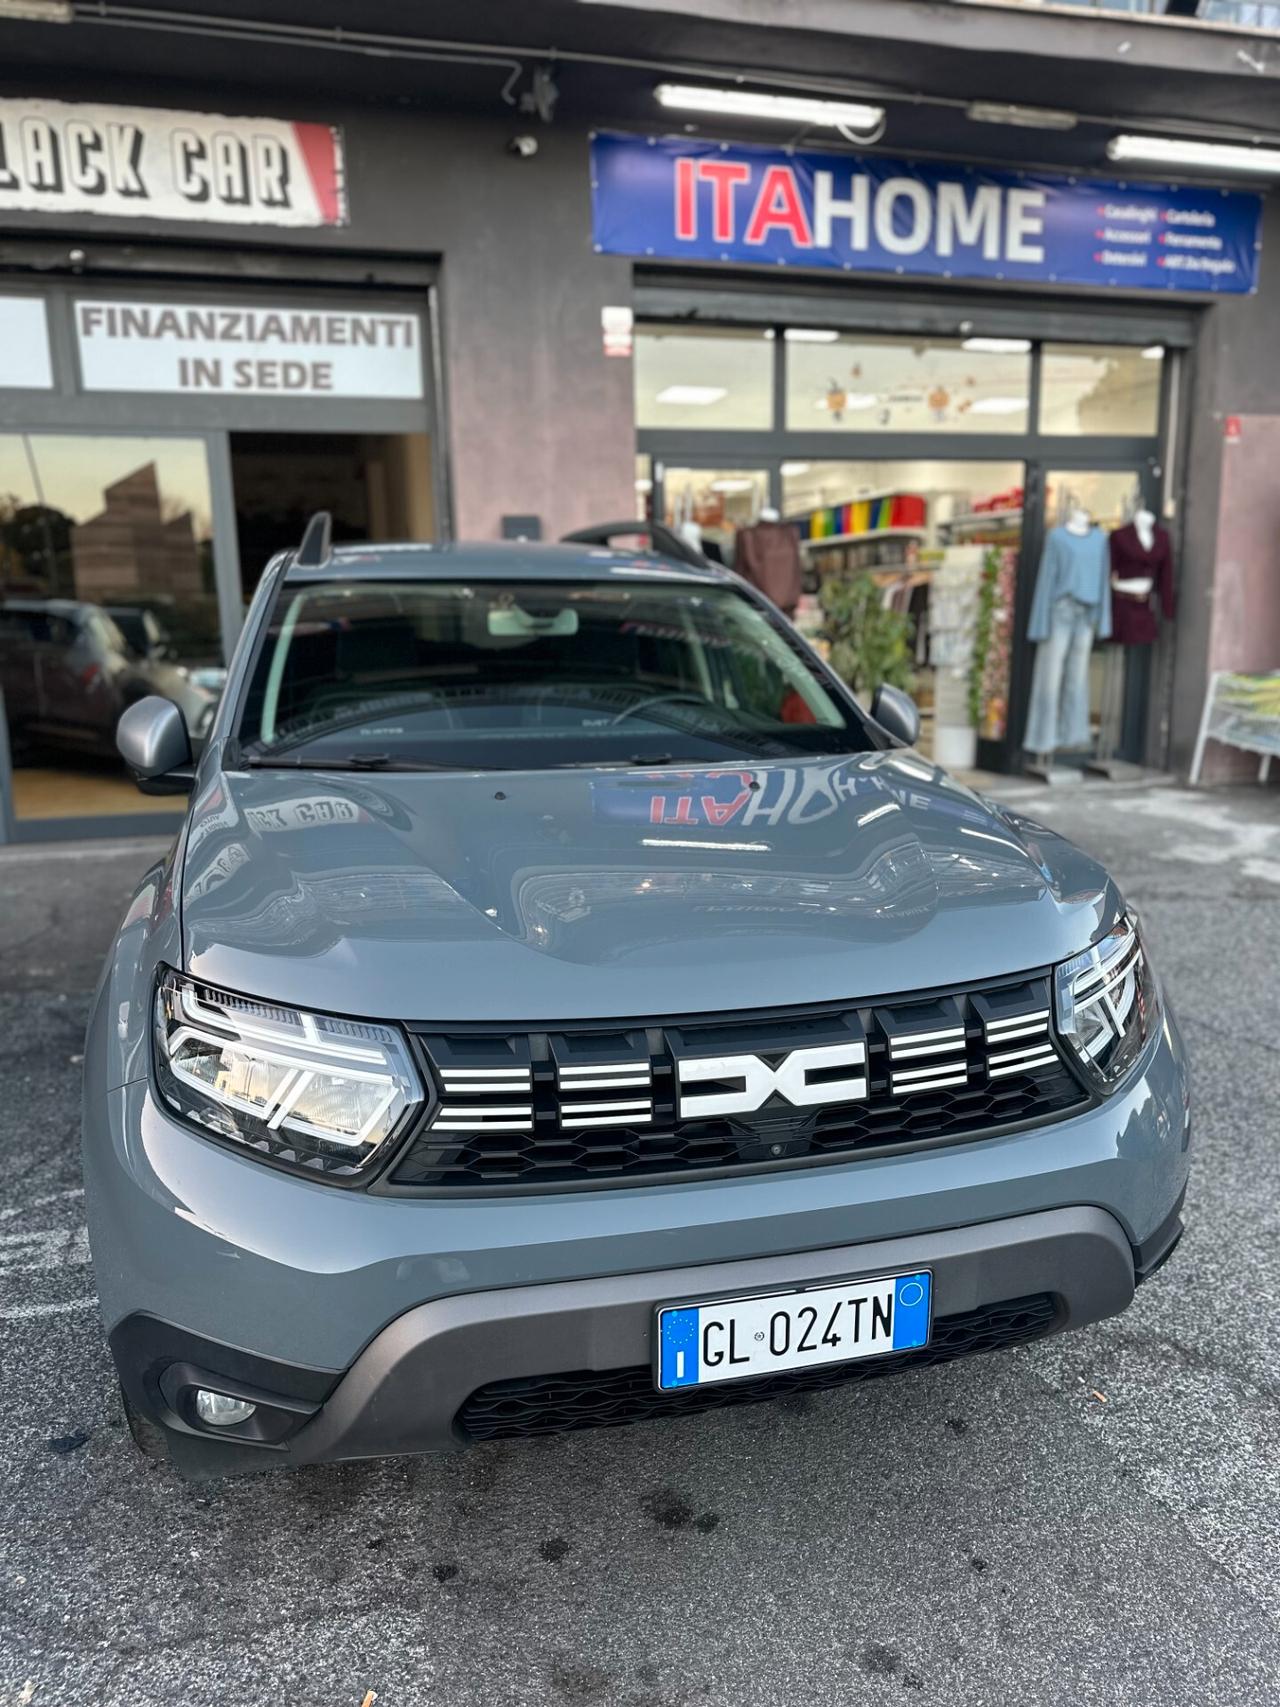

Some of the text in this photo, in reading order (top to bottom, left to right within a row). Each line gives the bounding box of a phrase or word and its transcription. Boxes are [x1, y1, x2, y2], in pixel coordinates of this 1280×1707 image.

[169, 126, 291, 208] CAR
[675, 158, 1044, 263] ITAHOME
[81, 306, 413, 348] FINANZIAMENTI
[178, 358, 332, 389] IN SEDE
